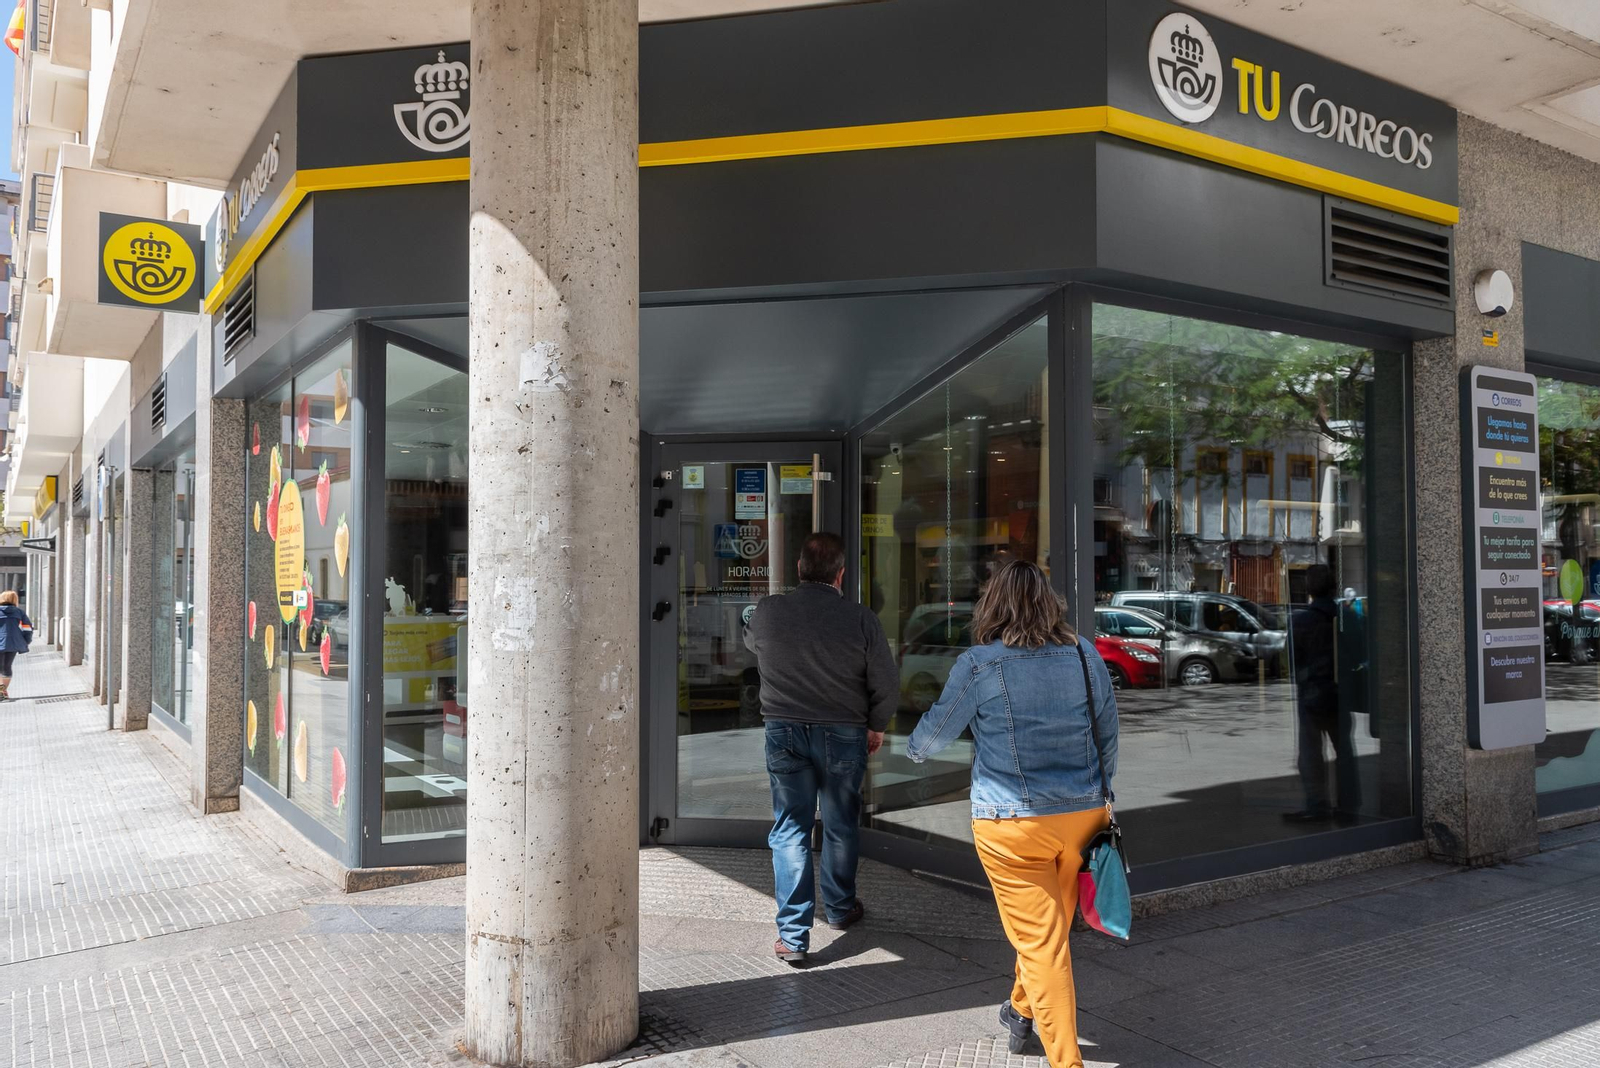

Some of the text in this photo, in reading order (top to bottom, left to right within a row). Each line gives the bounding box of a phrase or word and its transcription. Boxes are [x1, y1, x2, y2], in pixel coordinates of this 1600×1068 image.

[1231, 57, 1434, 170] TU CORREOS
[1501, 397, 1522, 407] CORREOS
[1487, 415, 1527, 430] Llegamos hasta
[1486, 428, 1503, 440] donde
[1511, 433, 1529, 444] quieras
[1489, 475, 1527, 487] Encuentra más
[1488, 488, 1528, 502] de lo que crees
[1483, 535, 1534, 549] Tu mejor tarifa para
[1488, 549, 1531, 561] seguir conectado
[728, 566, 774, 577] HORARIO
[1493, 596, 1528, 605] Tus envíos en
[1486, 608, 1536, 621] cualquier momento
[1561, 621, 1592, 645] Porque
[1490, 654, 1535, 667] Descubre nuestra
[1505, 671, 1523, 679] marca
